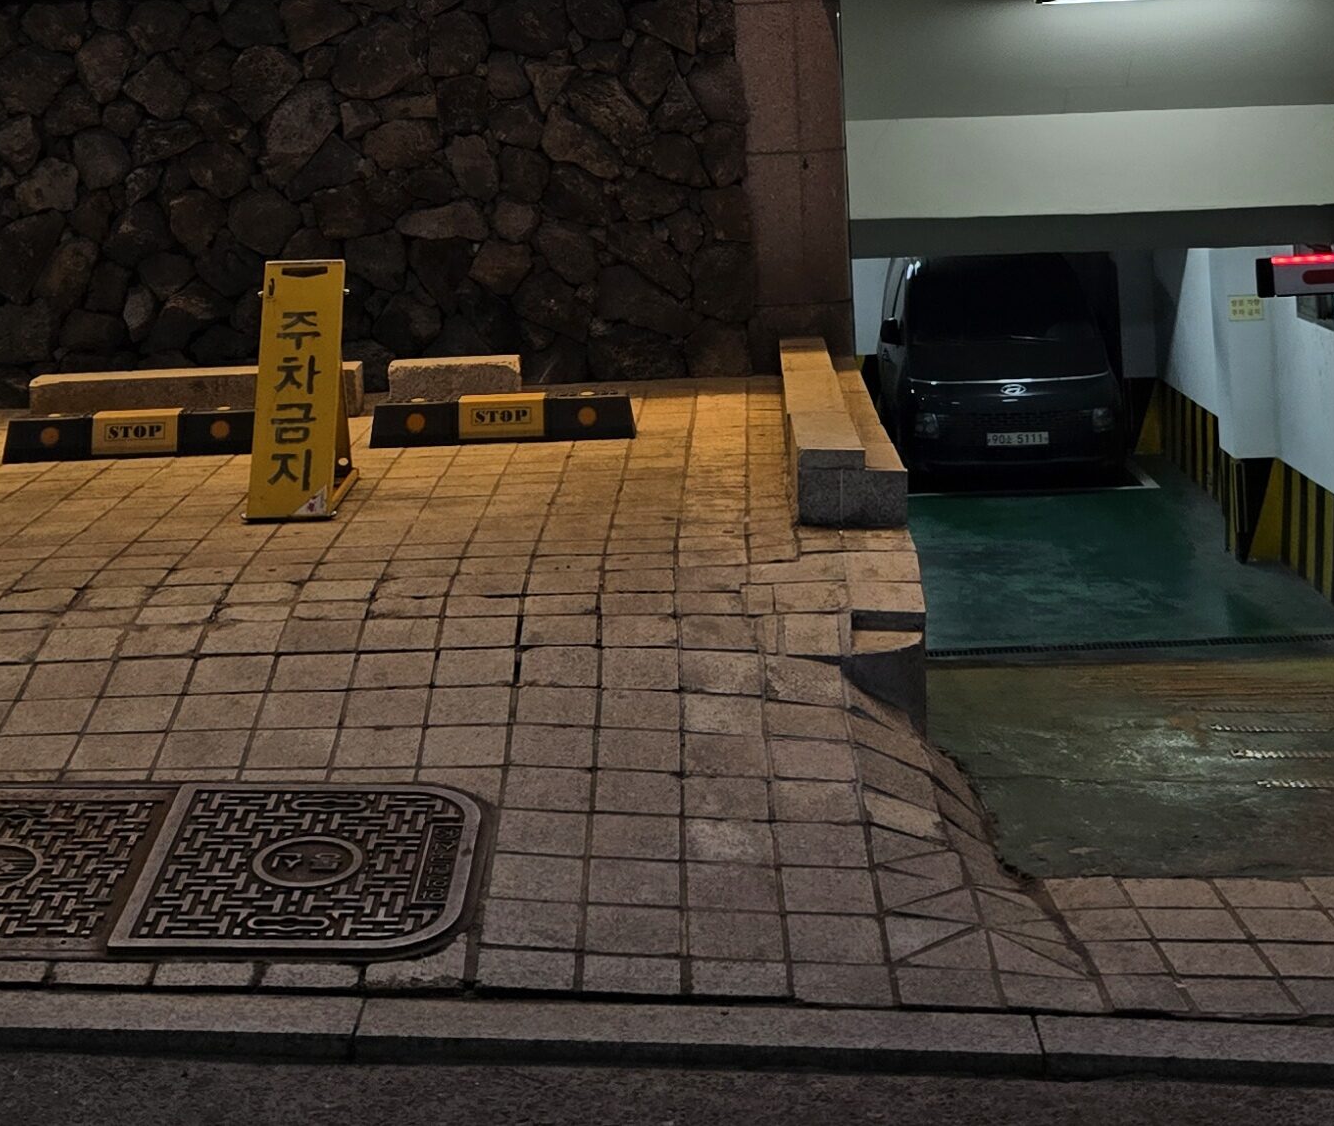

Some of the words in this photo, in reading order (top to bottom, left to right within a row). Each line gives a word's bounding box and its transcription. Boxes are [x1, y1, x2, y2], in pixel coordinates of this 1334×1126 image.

[267, 311, 322, 491] 주차금지
[474, 408, 529, 425] STOP
[108, 424, 163, 440] STOP
